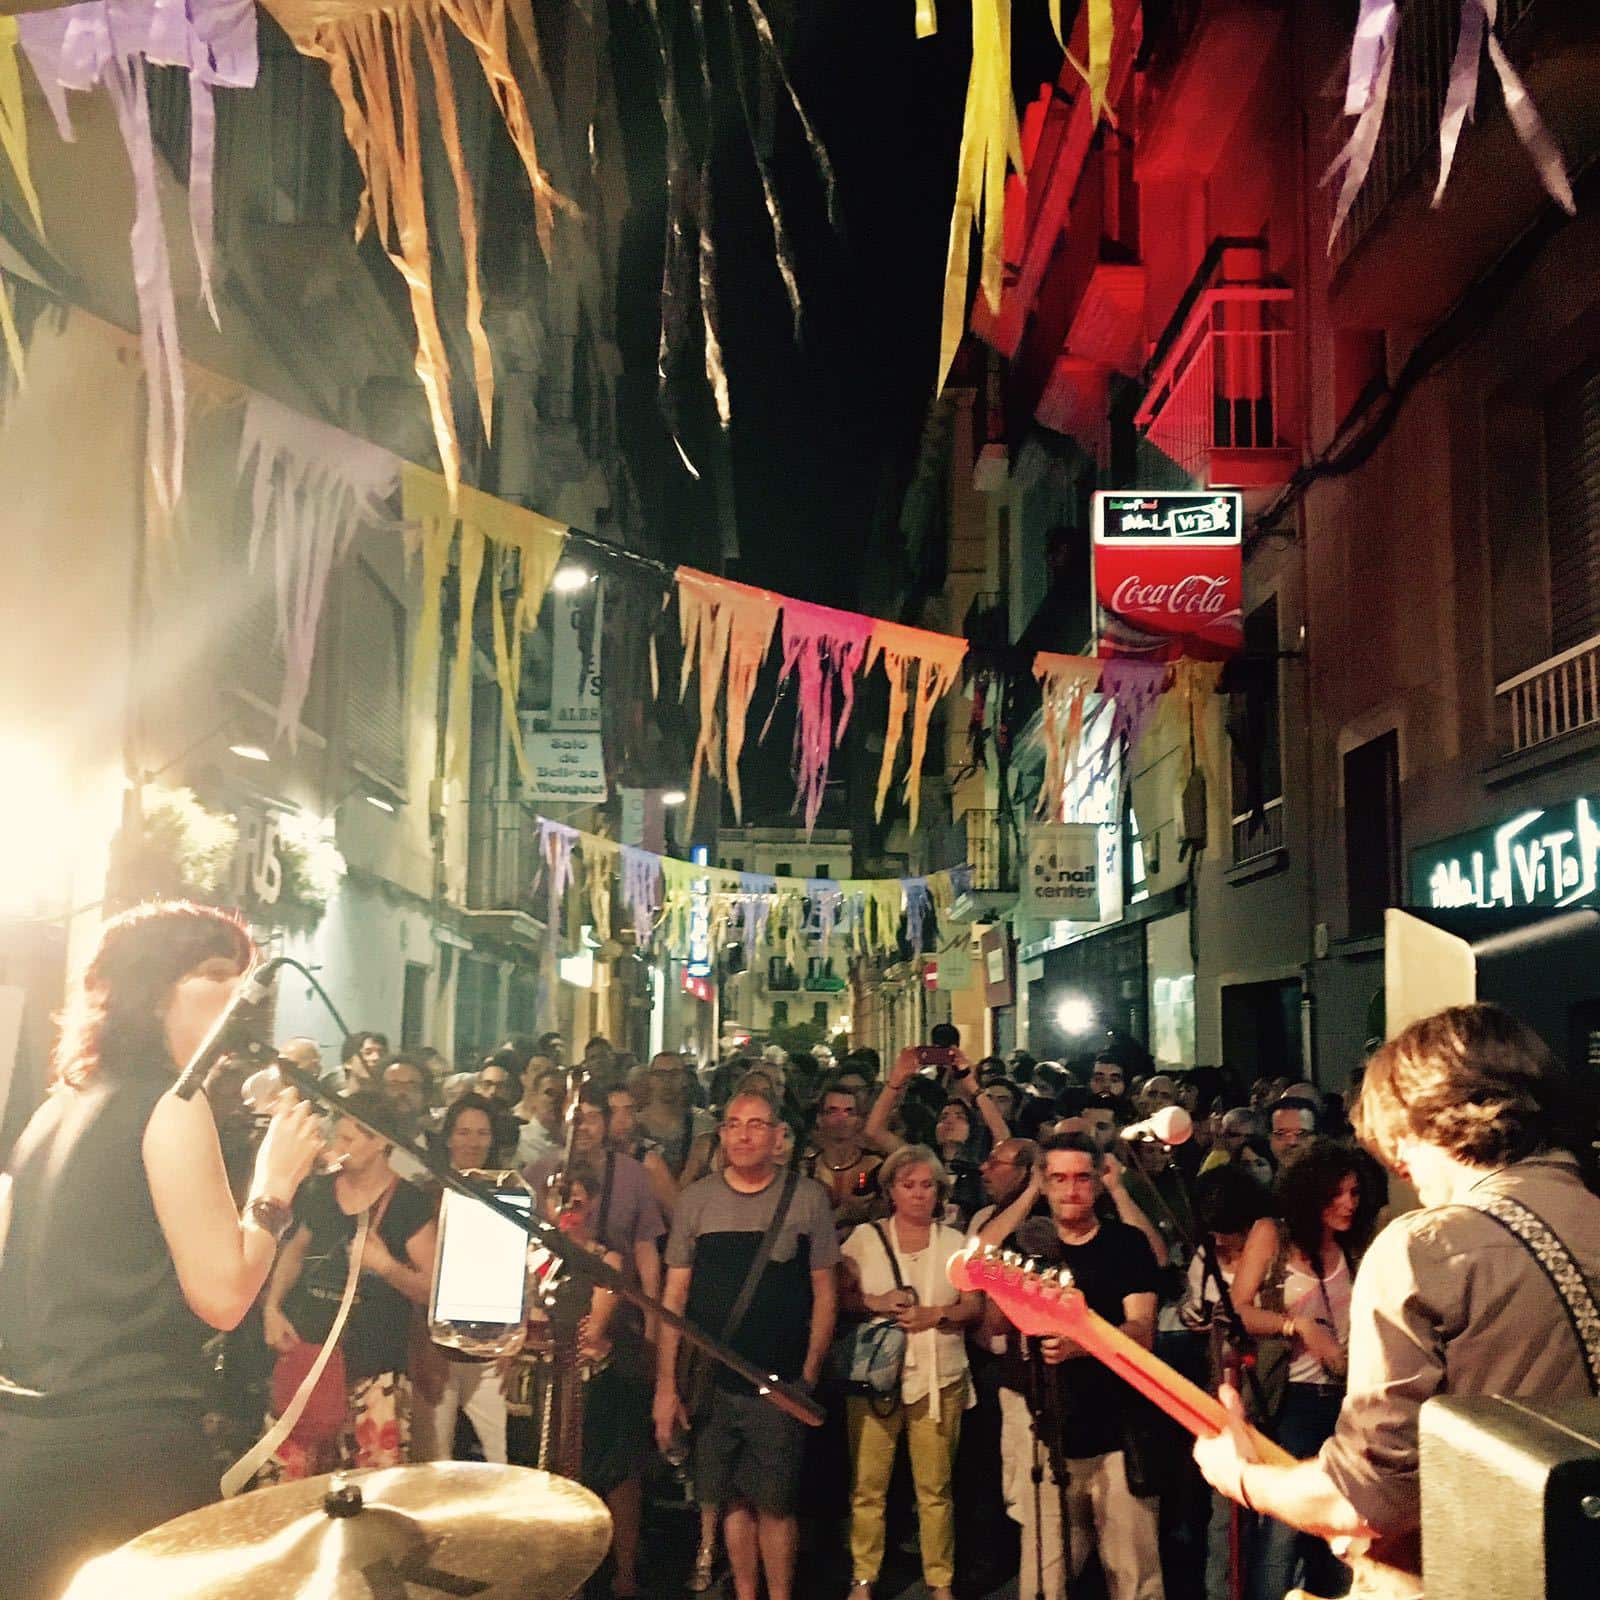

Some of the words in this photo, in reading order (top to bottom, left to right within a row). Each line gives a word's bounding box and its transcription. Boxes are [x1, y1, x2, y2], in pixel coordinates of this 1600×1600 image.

[1112, 576, 1231, 613] Coca-Cola
[1059, 865, 1096, 882] nail
[1035, 885, 1096, 898] center
